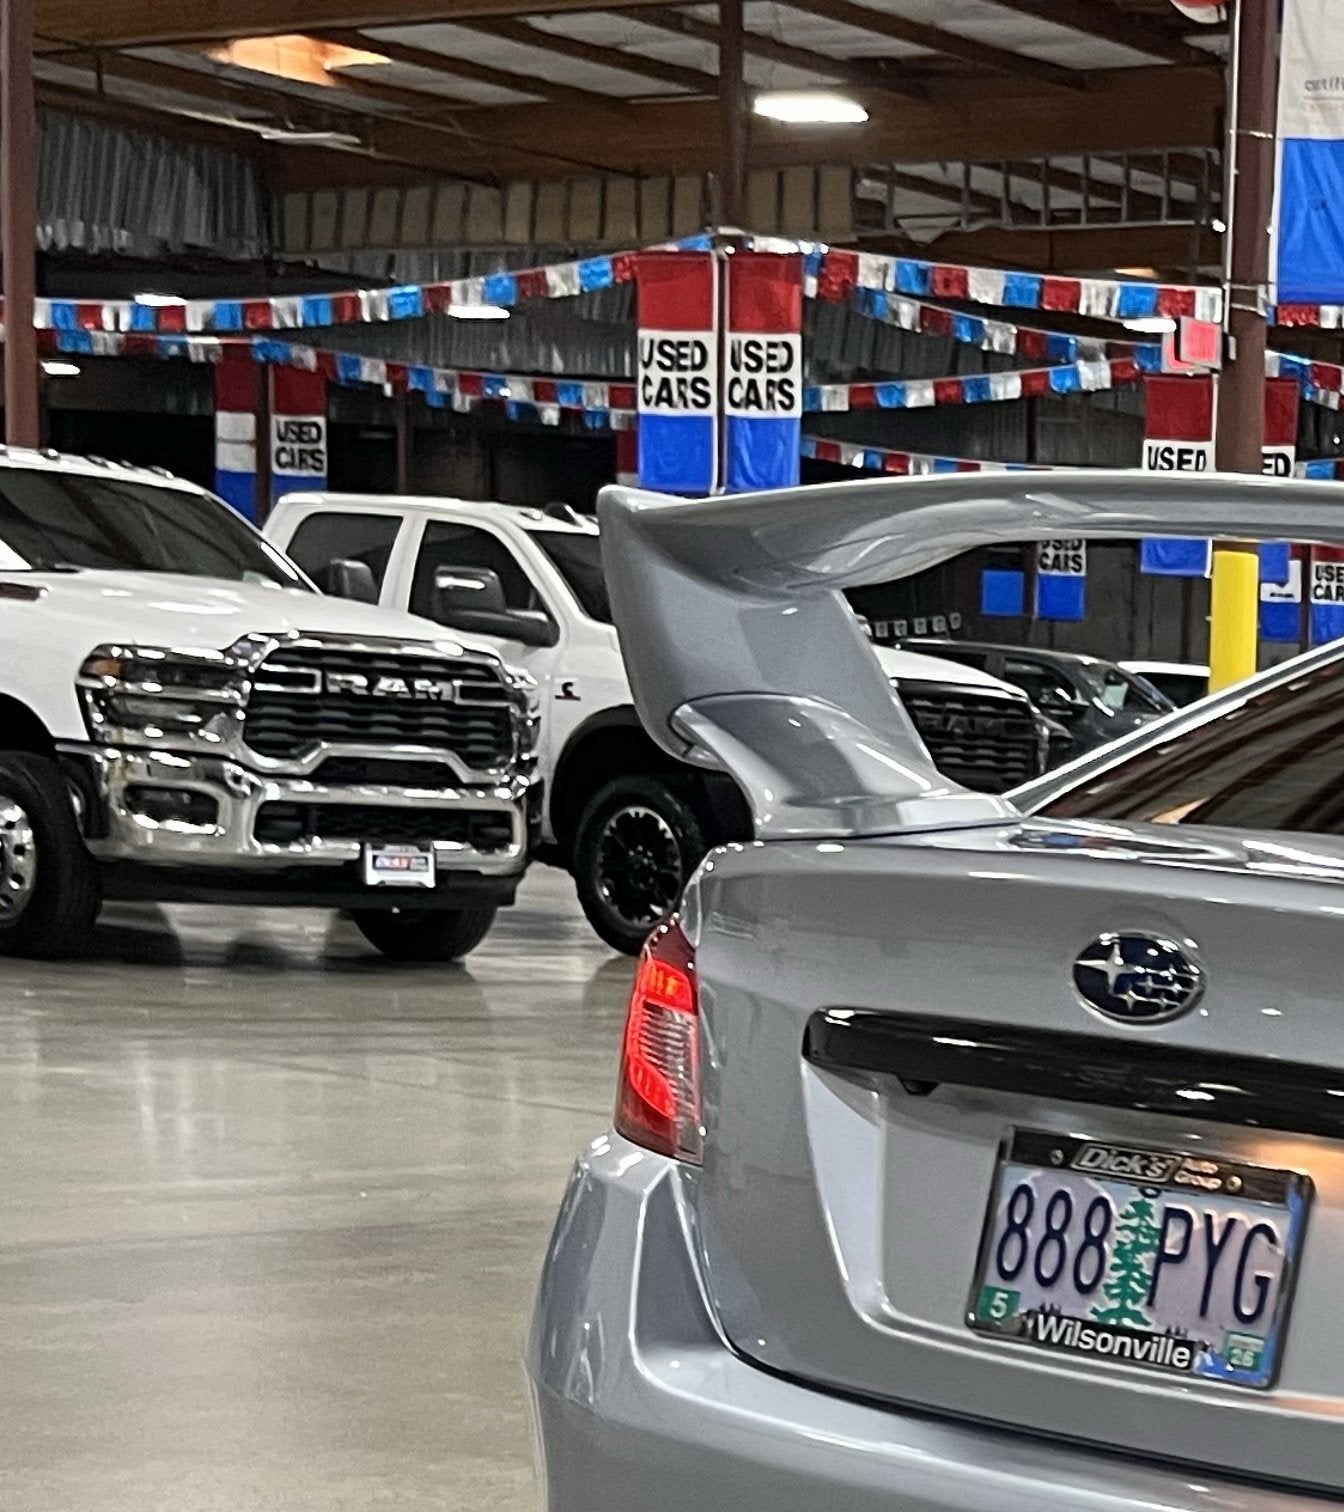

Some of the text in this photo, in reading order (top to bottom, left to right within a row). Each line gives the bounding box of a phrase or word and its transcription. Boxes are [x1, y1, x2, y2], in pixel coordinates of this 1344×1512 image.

[640, 338, 708, 372] USED
[730, 340, 794, 373] USED
[642, 375, 712, 410] CARS
[728, 377, 795, 411] CARS
[276, 421, 322, 444] USED
[1148, 446, 1207, 471] USED
[1261, 452, 1291, 477] ED
[326, 671, 453, 701] RAM
[1079, 1147, 1168, 1178] Dick's
[996, 1183, 1279, 1325] 888 PYG
[989, 1291, 1009, 1319] 5
[1036, 1313, 1192, 1369] Wilsonville
